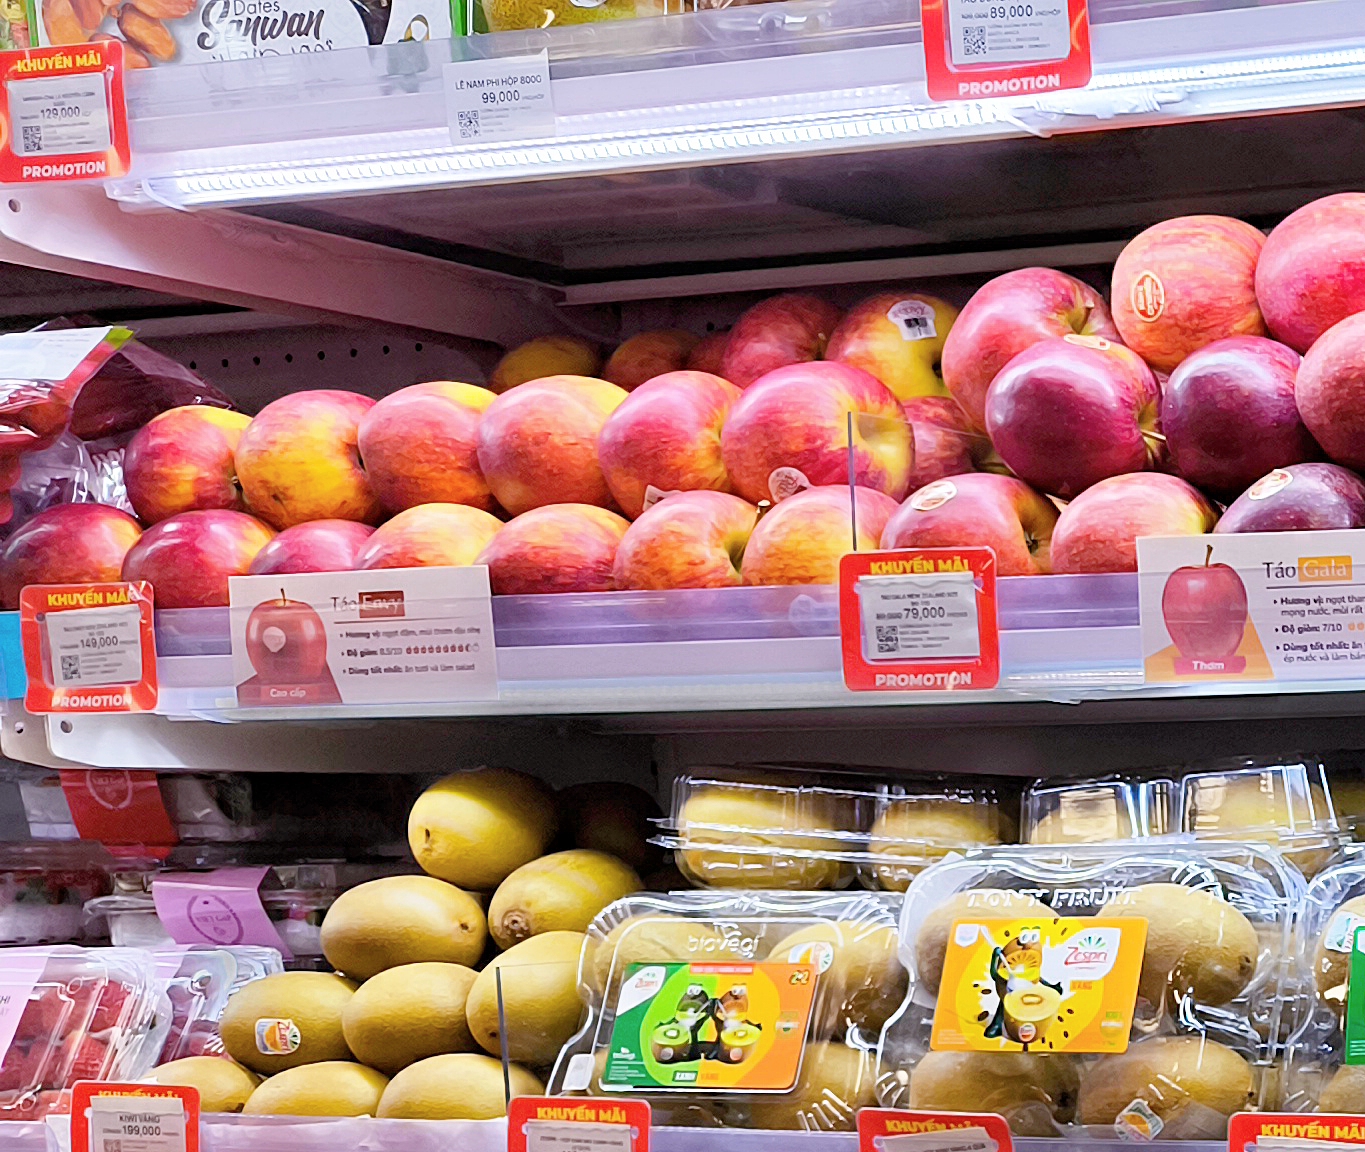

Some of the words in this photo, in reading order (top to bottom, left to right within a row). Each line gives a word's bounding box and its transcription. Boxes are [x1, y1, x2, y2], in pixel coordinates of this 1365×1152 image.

[234, 0, 280, 15] Dates
[990, 5, 1033, 20] 89,000
[17, 52, 72, 72] KHUYẾN
[76, 50, 101, 66] MÃI
[467, 80, 484, 89] NAM
[958, 74, 1060, 95] PROMOTION
[482, 90, 519, 105] 99,000
[41, 106, 80, 120] 129,000
[23, 160, 105, 178] PROMOTION
[870, 555, 934, 575] KHUYẾN
[938, 556, 969, 572] MÃI
[1262, 562, 1297, 579] Táo
[1303, 559, 1348, 578] Gala
[48, 588, 102, 605] KHUYẾN
[903, 607, 945, 621] 79,000
[1323, 622, 1343, 632] 7/10
[875, 672, 972, 686] PROMOTION
[52, 695, 132, 707] PROMOTION
[537, 1105, 595, 1120] KHUYẾN
[599, 1107, 626, 1123] MÃI
[122, 1125, 161, 1137] 199,000
[1261, 1120, 1330, 1138] KHUYẾN
[1334, 1123, 1365, 1140] MÃI
